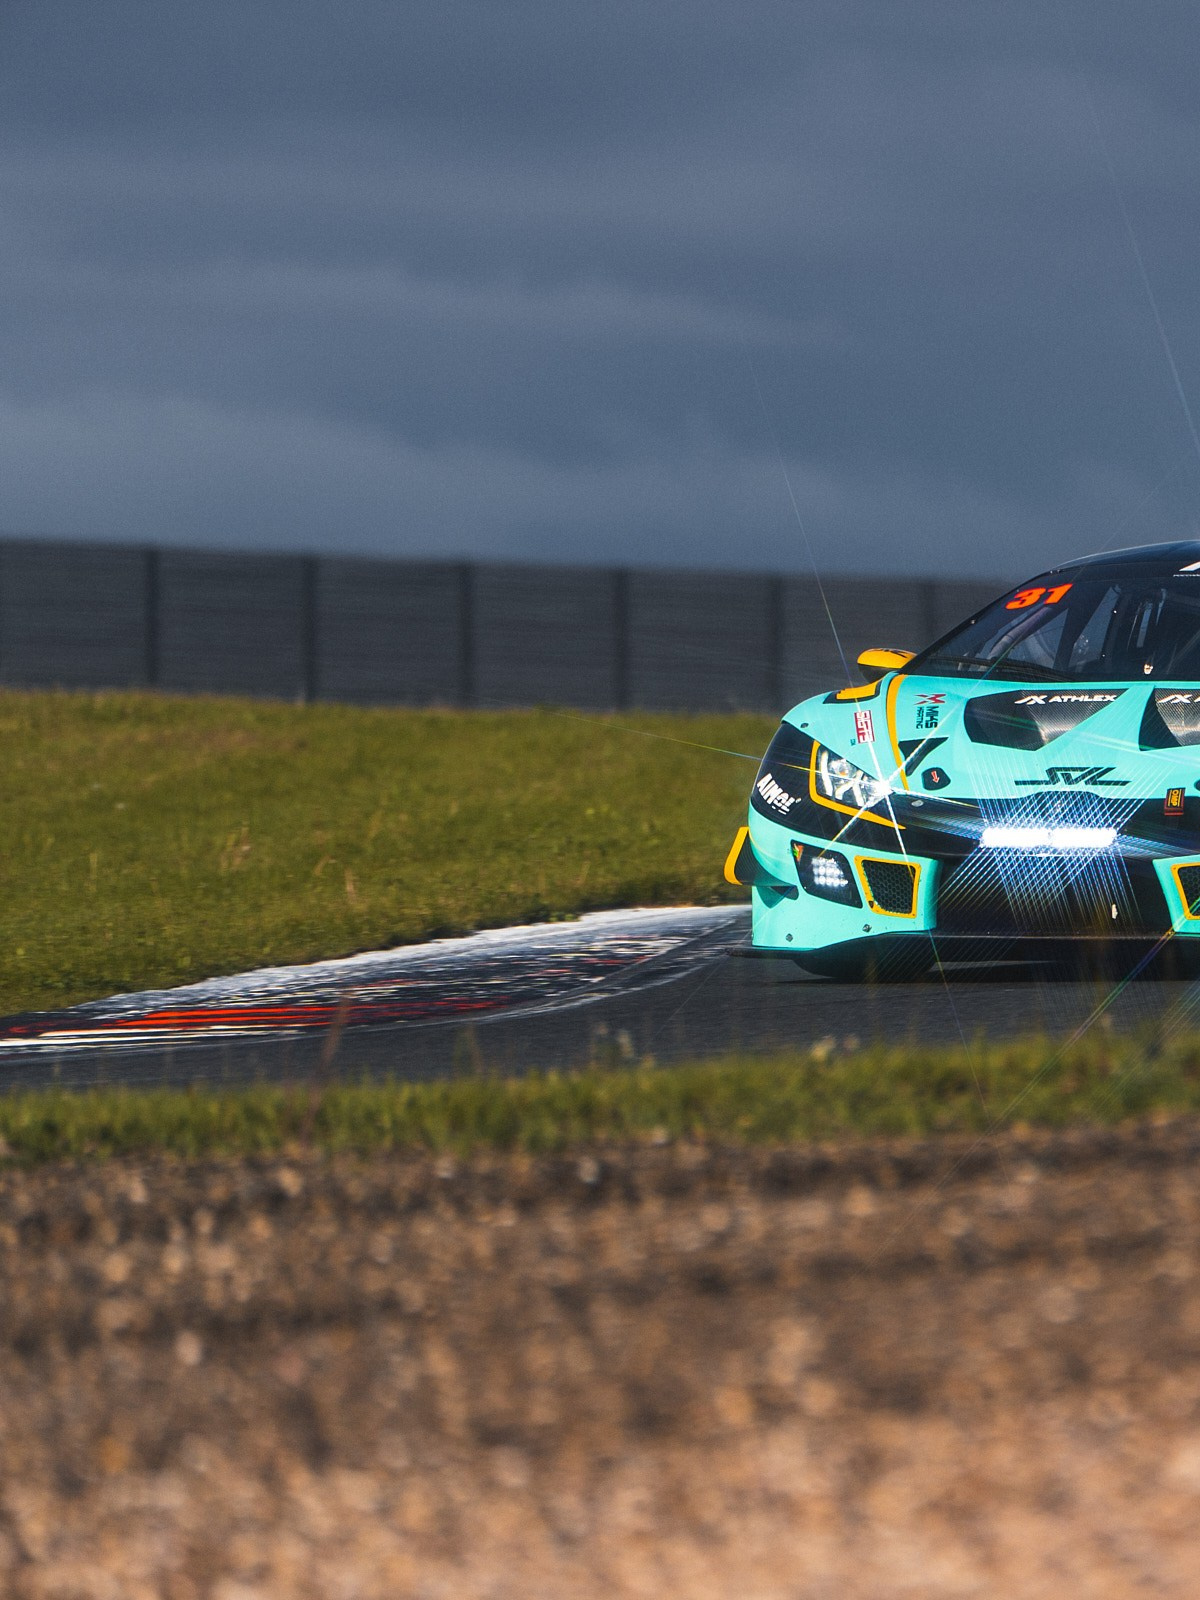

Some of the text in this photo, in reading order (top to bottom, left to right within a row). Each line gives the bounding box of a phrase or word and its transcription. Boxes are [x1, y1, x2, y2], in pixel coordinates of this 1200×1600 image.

[1005, 583, 1073, 610] 31
[1048, 694, 1117, 703] ATHLEX
[1014, 766, 1132, 786] SVL
